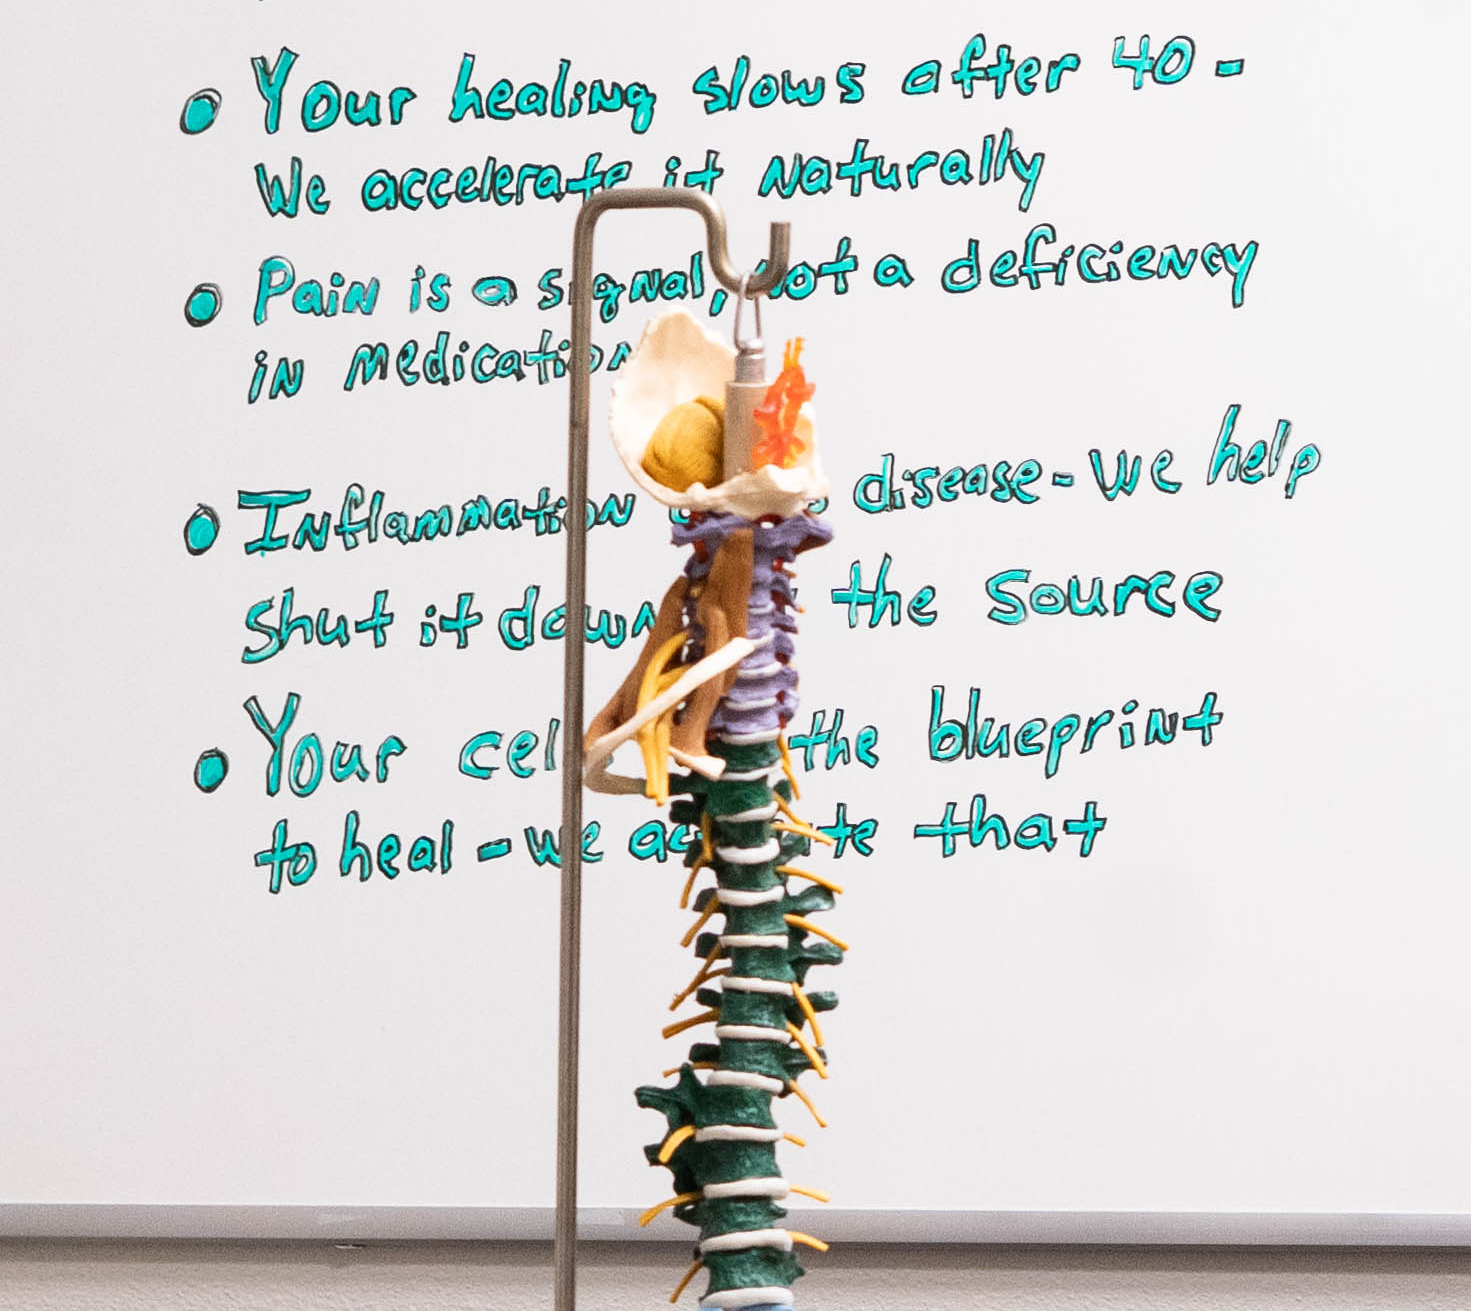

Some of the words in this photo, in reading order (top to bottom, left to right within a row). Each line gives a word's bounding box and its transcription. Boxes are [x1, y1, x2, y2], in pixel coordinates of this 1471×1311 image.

[251, 46, 417, 134] Your
[693, 55, 866, 115] slows
[902, 33, 1081, 99] after
[254, 157, 330, 218] We
[254, 256, 380, 326] Pain
[410, 265, 451, 312] is
[472, 276, 518, 306] a
[874, 254, 914, 288] a
[941, 223, 1259, 308] deficiency
[1207, 404, 1321, 499] help
[420, 592, 483, 648] it
[831, 553, 937, 628] the
[243, 692, 407, 798] Your
[788, 711, 880, 772] the
[929, 685, 1223, 779] blueprint
[254, 819, 317, 894] to
[914, 794, 1107, 858] that
